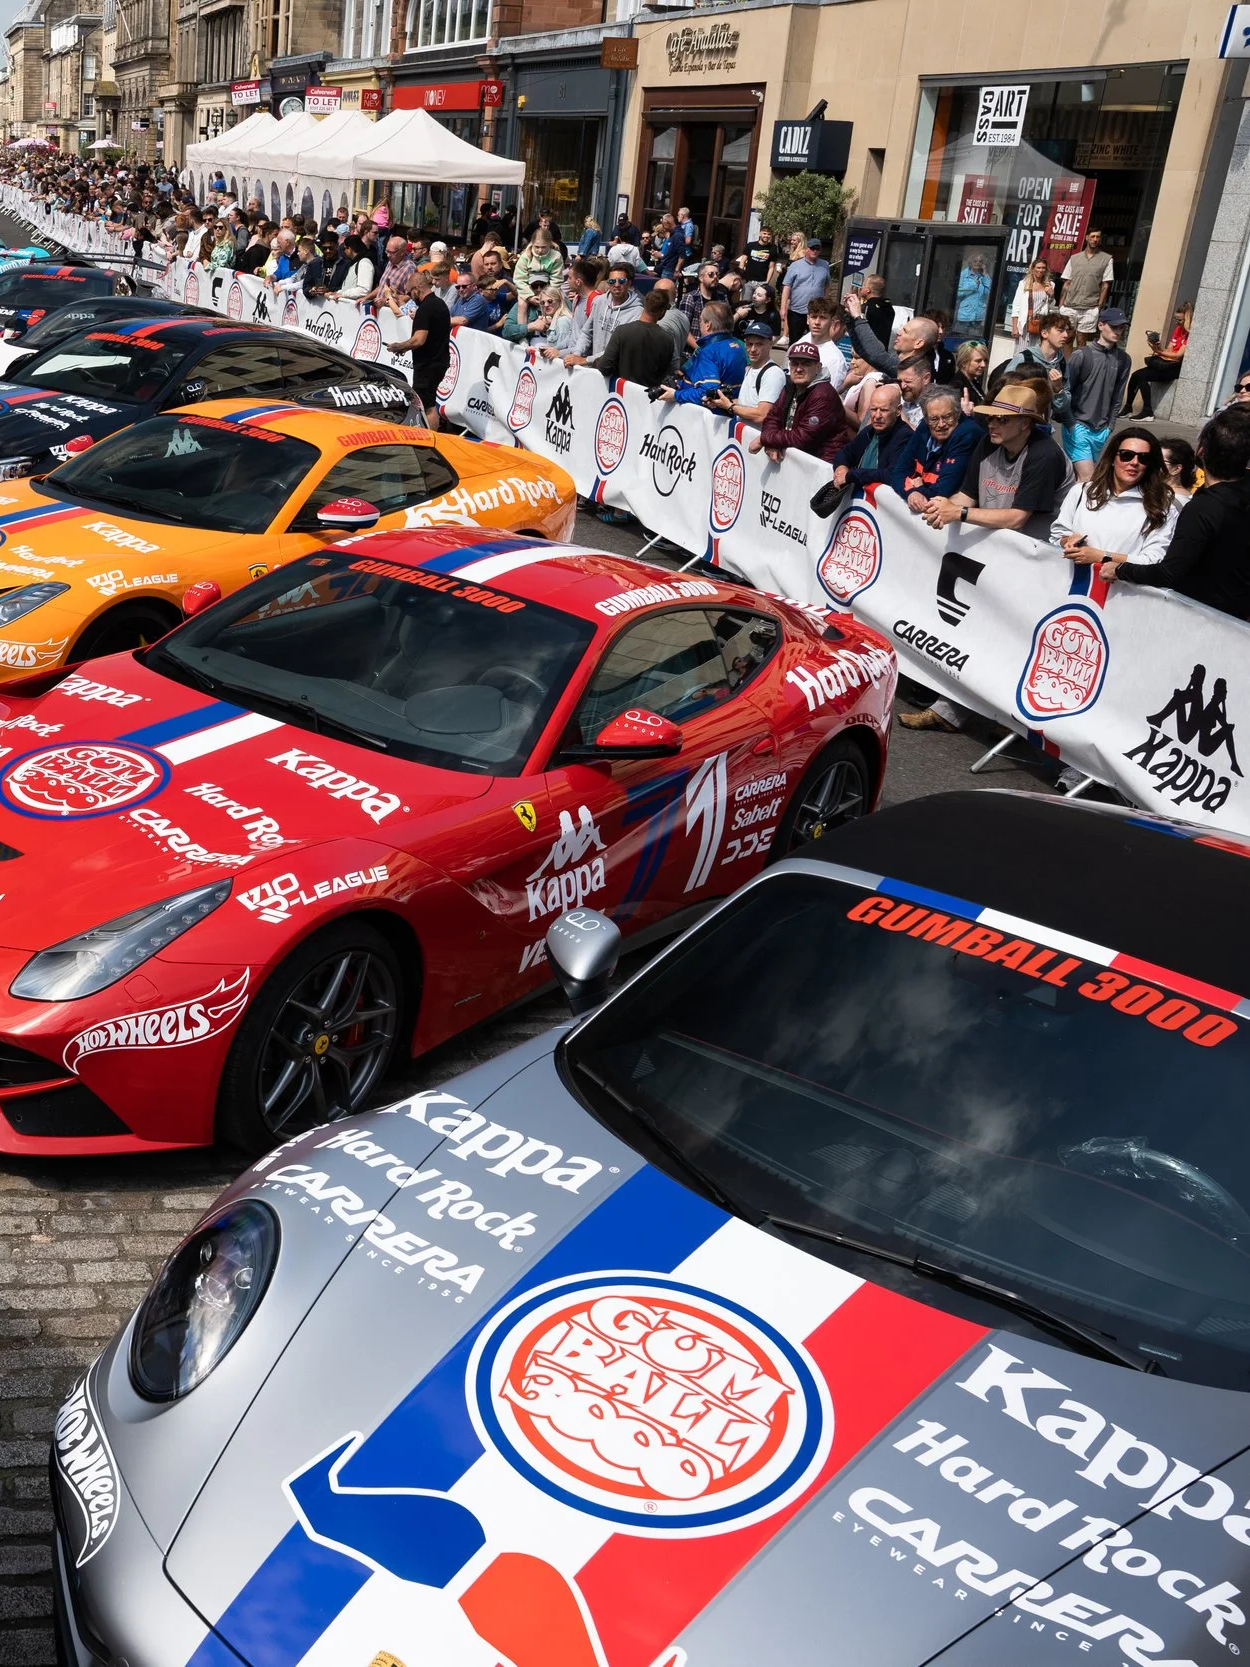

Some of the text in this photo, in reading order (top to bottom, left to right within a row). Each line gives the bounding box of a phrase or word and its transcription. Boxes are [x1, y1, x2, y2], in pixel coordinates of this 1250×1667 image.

[233, 90, 258, 99] TO LET
[307, 97, 338, 106] TO LET
[992, 89, 1028, 118] ART
[976, 90, 995, 143] CASS
[779, 127, 812, 155] CADIZ
[988, 133, 1016, 144] EST.1984
[1017, 177, 1052, 200] OPEN
[1015, 204, 1043, 227] FOR
[1052, 213, 1082, 236] SALE
[1006, 230, 1044, 263] ART
[305, 318, 344, 345] Hard Rock
[793, 345, 815, 355] NYC
[59, 394, 118, 414] Kappa
[327, 384, 411, 408] Hard Rock
[176, 415, 287, 443] GUMBALL 3000
[545, 418, 572, 454] Kappa
[600, 426, 623, 443] BALL
[601, 411, 625, 426] GUM
[336, 430, 397, 448] GUMBALL
[639, 432, 697, 482] Hard Rock
[715, 477, 741, 498] BALL
[717, 458, 742, 484] GUM
[452, 475, 560, 516] Hard Rock
[82, 521, 161, 554] Kappa
[837, 522, 877, 553] GUM
[832, 541, 874, 574] BALL
[348, 558, 528, 614] GUMBALL 3000
[594, 581, 719, 617] GUMBALL 3000
[892, 619, 971, 673] CARRERA
[1045, 621, 1103, 664] GUM
[786, 642, 896, 712] Hard Rock
[1040, 643, 1098, 690] BALL
[4, 712, 61, 738] Rock
[614, 721, 664, 740] LONDON
[38, 754, 134, 800] BALL
[64, 746, 157, 784] GUM
[1122, 726, 1233, 814] Kappa
[183, 782, 250, 820] Hard
[265, 747, 402, 825] Kappa
[734, 772, 787, 801] CARRERA
[731, 797, 782, 831] Sabelt
[127, 808, 256, 866] CARRERA
[525, 857, 607, 923] Kappa
[846, 895, 1239, 1048] GUMBALL 3000
[76, 1002, 211, 1057] HOT WHEELS
[377, 1089, 604, 1194] Kappa
[313, 1128, 443, 1189] Hard
[415, 1178, 539, 1252] Rock
[264, 1163, 486, 1295] CARRERA
[344, 1233, 406, 1275] SINCE
[417, 1276, 465, 1304] 1956
[588, 1295, 795, 1412] GUM
[540, 1318, 770, 1474] BALL
[55, 1389, 115, 1540] HOT WHEELS
[892, 1418, 1246, 1646] Hard Rock
[832, 1510, 1094, 1653] EYEWEAR SINCE
[848, 1486, 1202, 1667] CARRER
